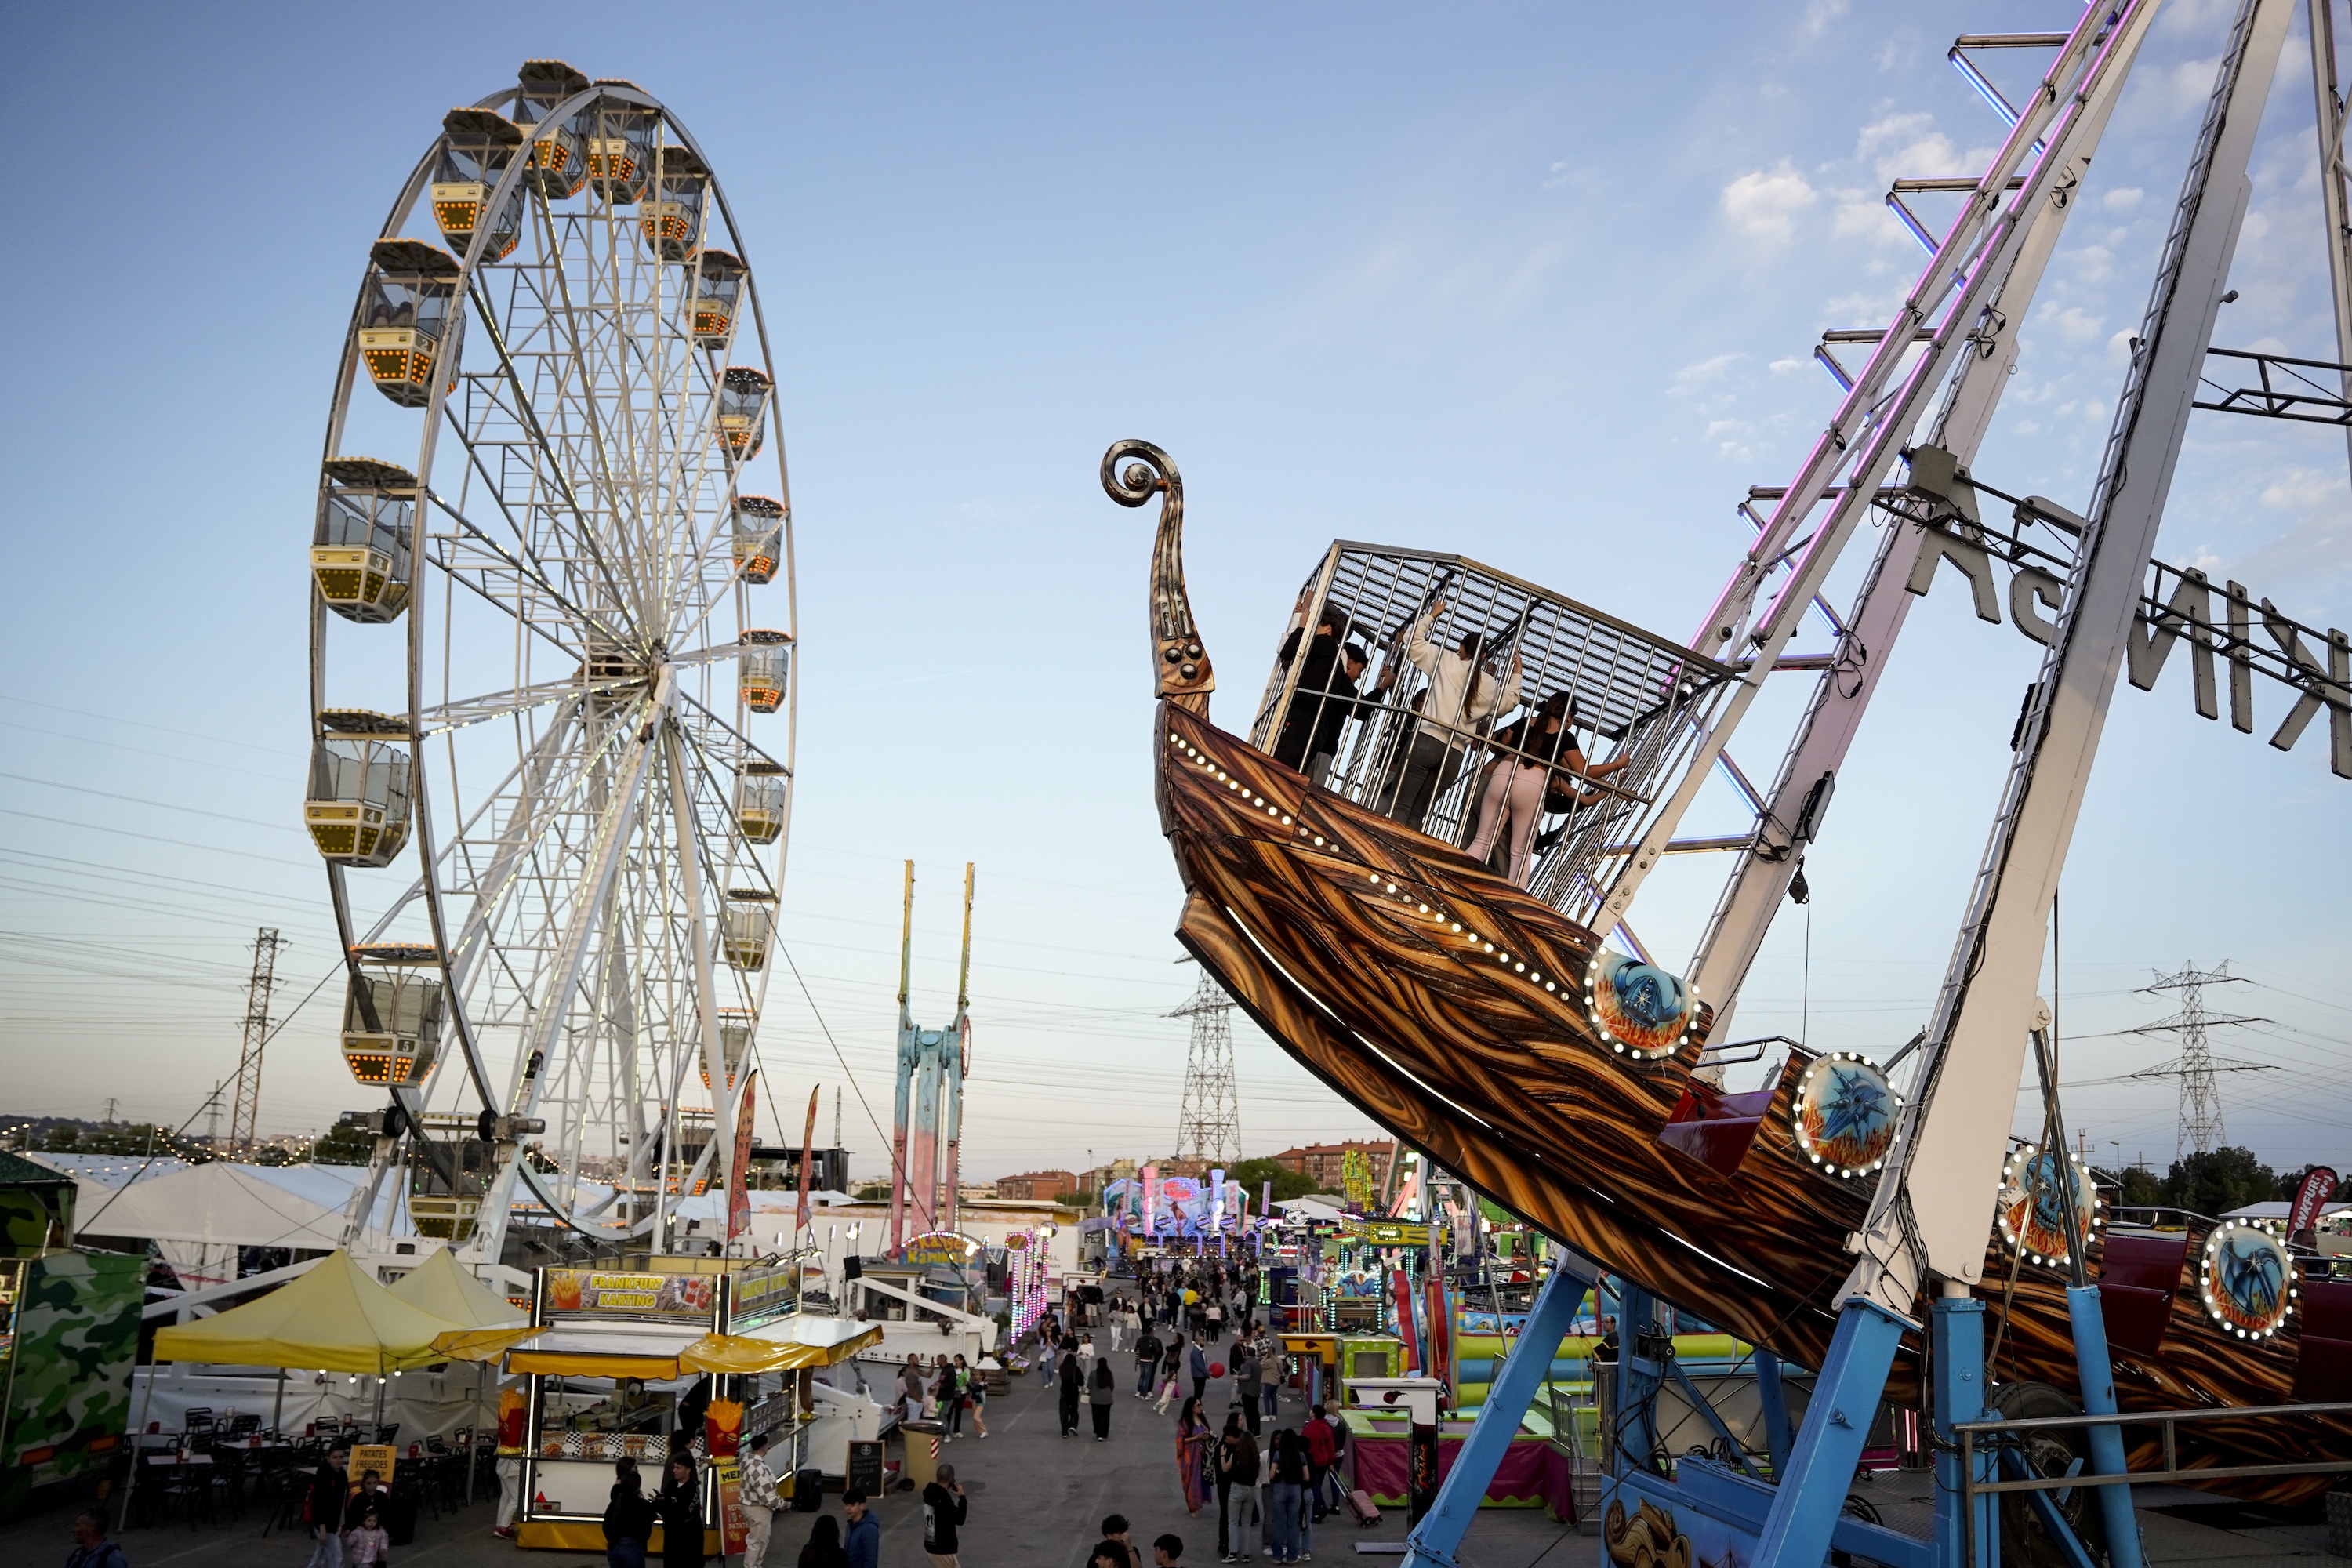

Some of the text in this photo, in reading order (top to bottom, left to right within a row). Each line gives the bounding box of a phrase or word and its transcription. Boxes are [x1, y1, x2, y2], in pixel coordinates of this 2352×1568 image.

[420, 338, 430, 349] 2
[375, 557, 383, 569] 3
[367, 809, 376, 822] 4
[402, 1040, 410, 1051] 5
[465, 1203, 472, 1214] 6
[591, 1276, 663, 1290] FRANKFURT
[599, 1294, 655, 1307] KARTING
[359, 1450, 387, 1458] PATATES
[355, 1460, 388, 1468] FREGIDES
